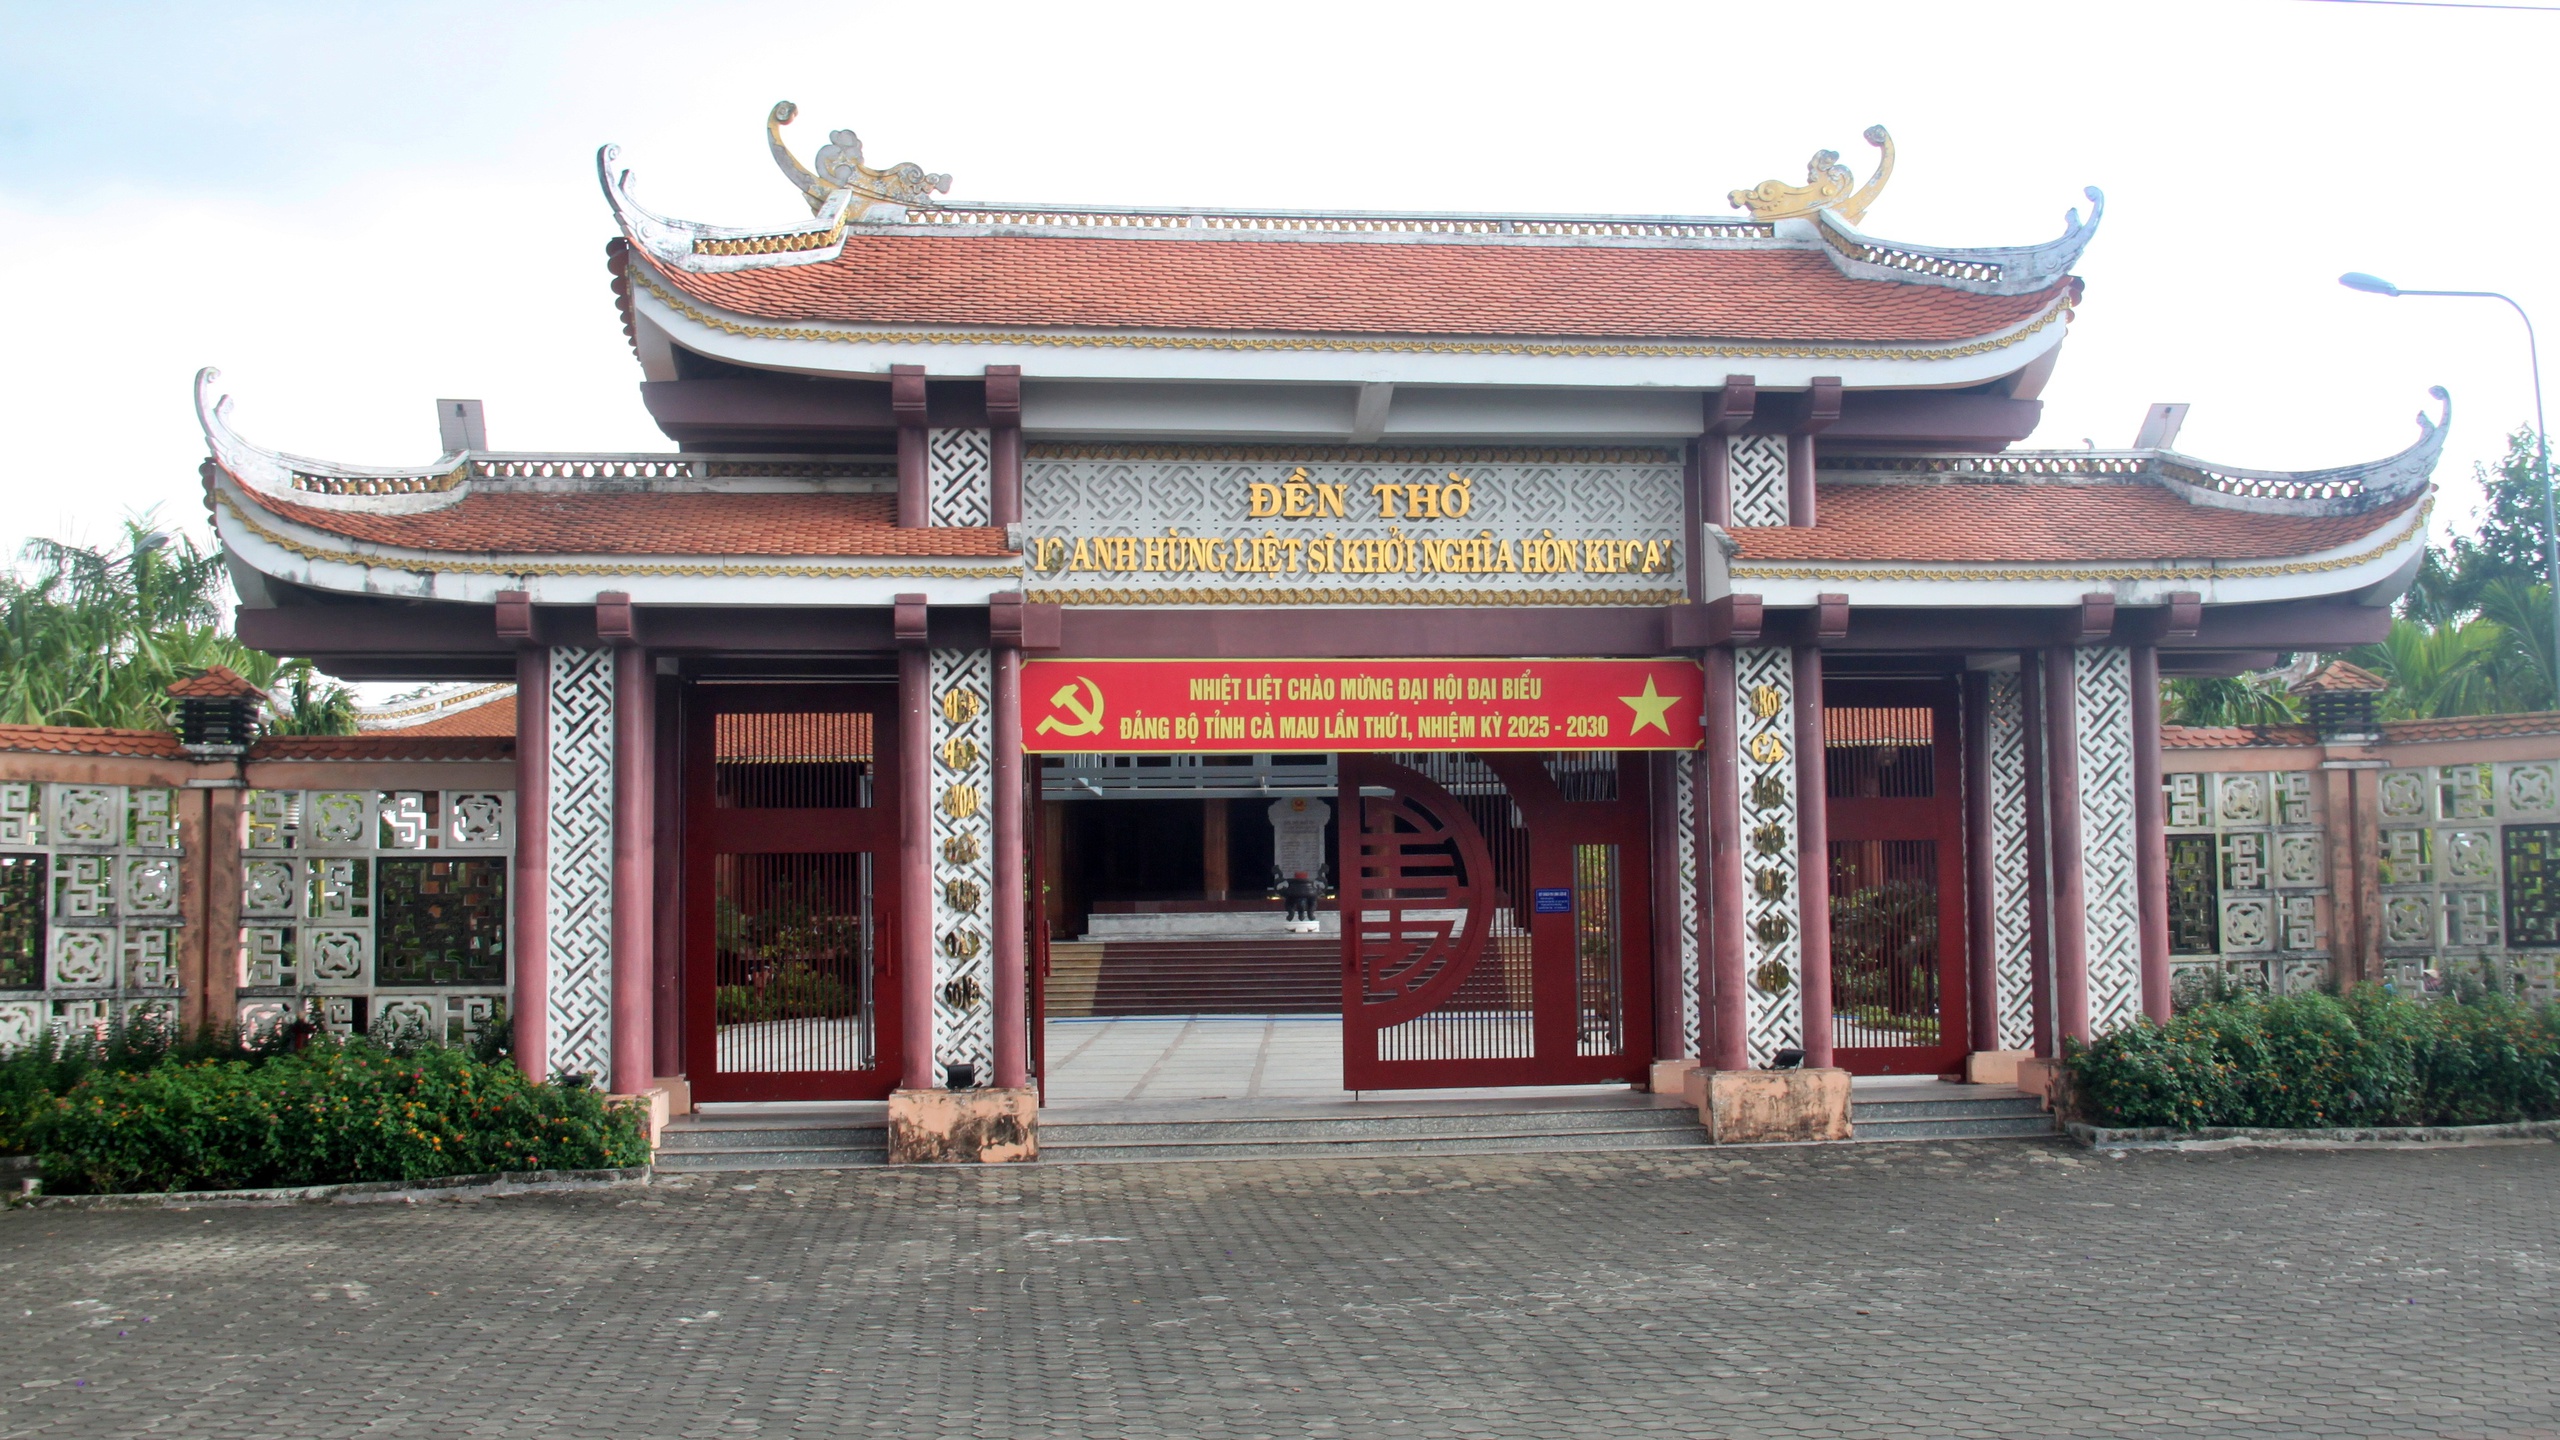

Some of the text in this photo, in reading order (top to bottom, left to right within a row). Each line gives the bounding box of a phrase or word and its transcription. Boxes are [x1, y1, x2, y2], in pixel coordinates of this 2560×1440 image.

[1249, 467, 1472, 518] ĐỀN THỜ
[1033, 536, 1064, 573] 10
[1069, 537, 1138, 573] ANH
[1142, 527, 1227, 574] HÙNG
[1233, 529, 1302, 579] LIỆT
[1341, 525, 1417, 574] KHỞI
[1521, 528, 1579, 574] HÒN
[1583, 539, 1674, 574] KHOAI
[1189, 668, 1542, 706] NHIỆT LIỆT CHÀO MỪNG ĐẠI HỘI ĐẠI BIỂU
[1120, 709, 1170, 740] ĐẢNG
[1175, 712, 1200, 744] BỘ
[1204, 709, 1246, 740] TỈNH
[1250, 711, 1275, 739] CÀ
[1279, 716, 1320, 739] MAU
[1324, 708, 1359, 739] LẦN
[1363, 711, 1399, 738] THỨ
[1401, 716, 1413, 741] I,
[1418, 711, 1475, 743] NHIỆM
[1480, 711, 1503, 738] KỲ
[1507, 715, 1549, 738] 2025
[1566, 715, 1609, 738] 2030
[1751, 732, 1784, 764] CÀ
